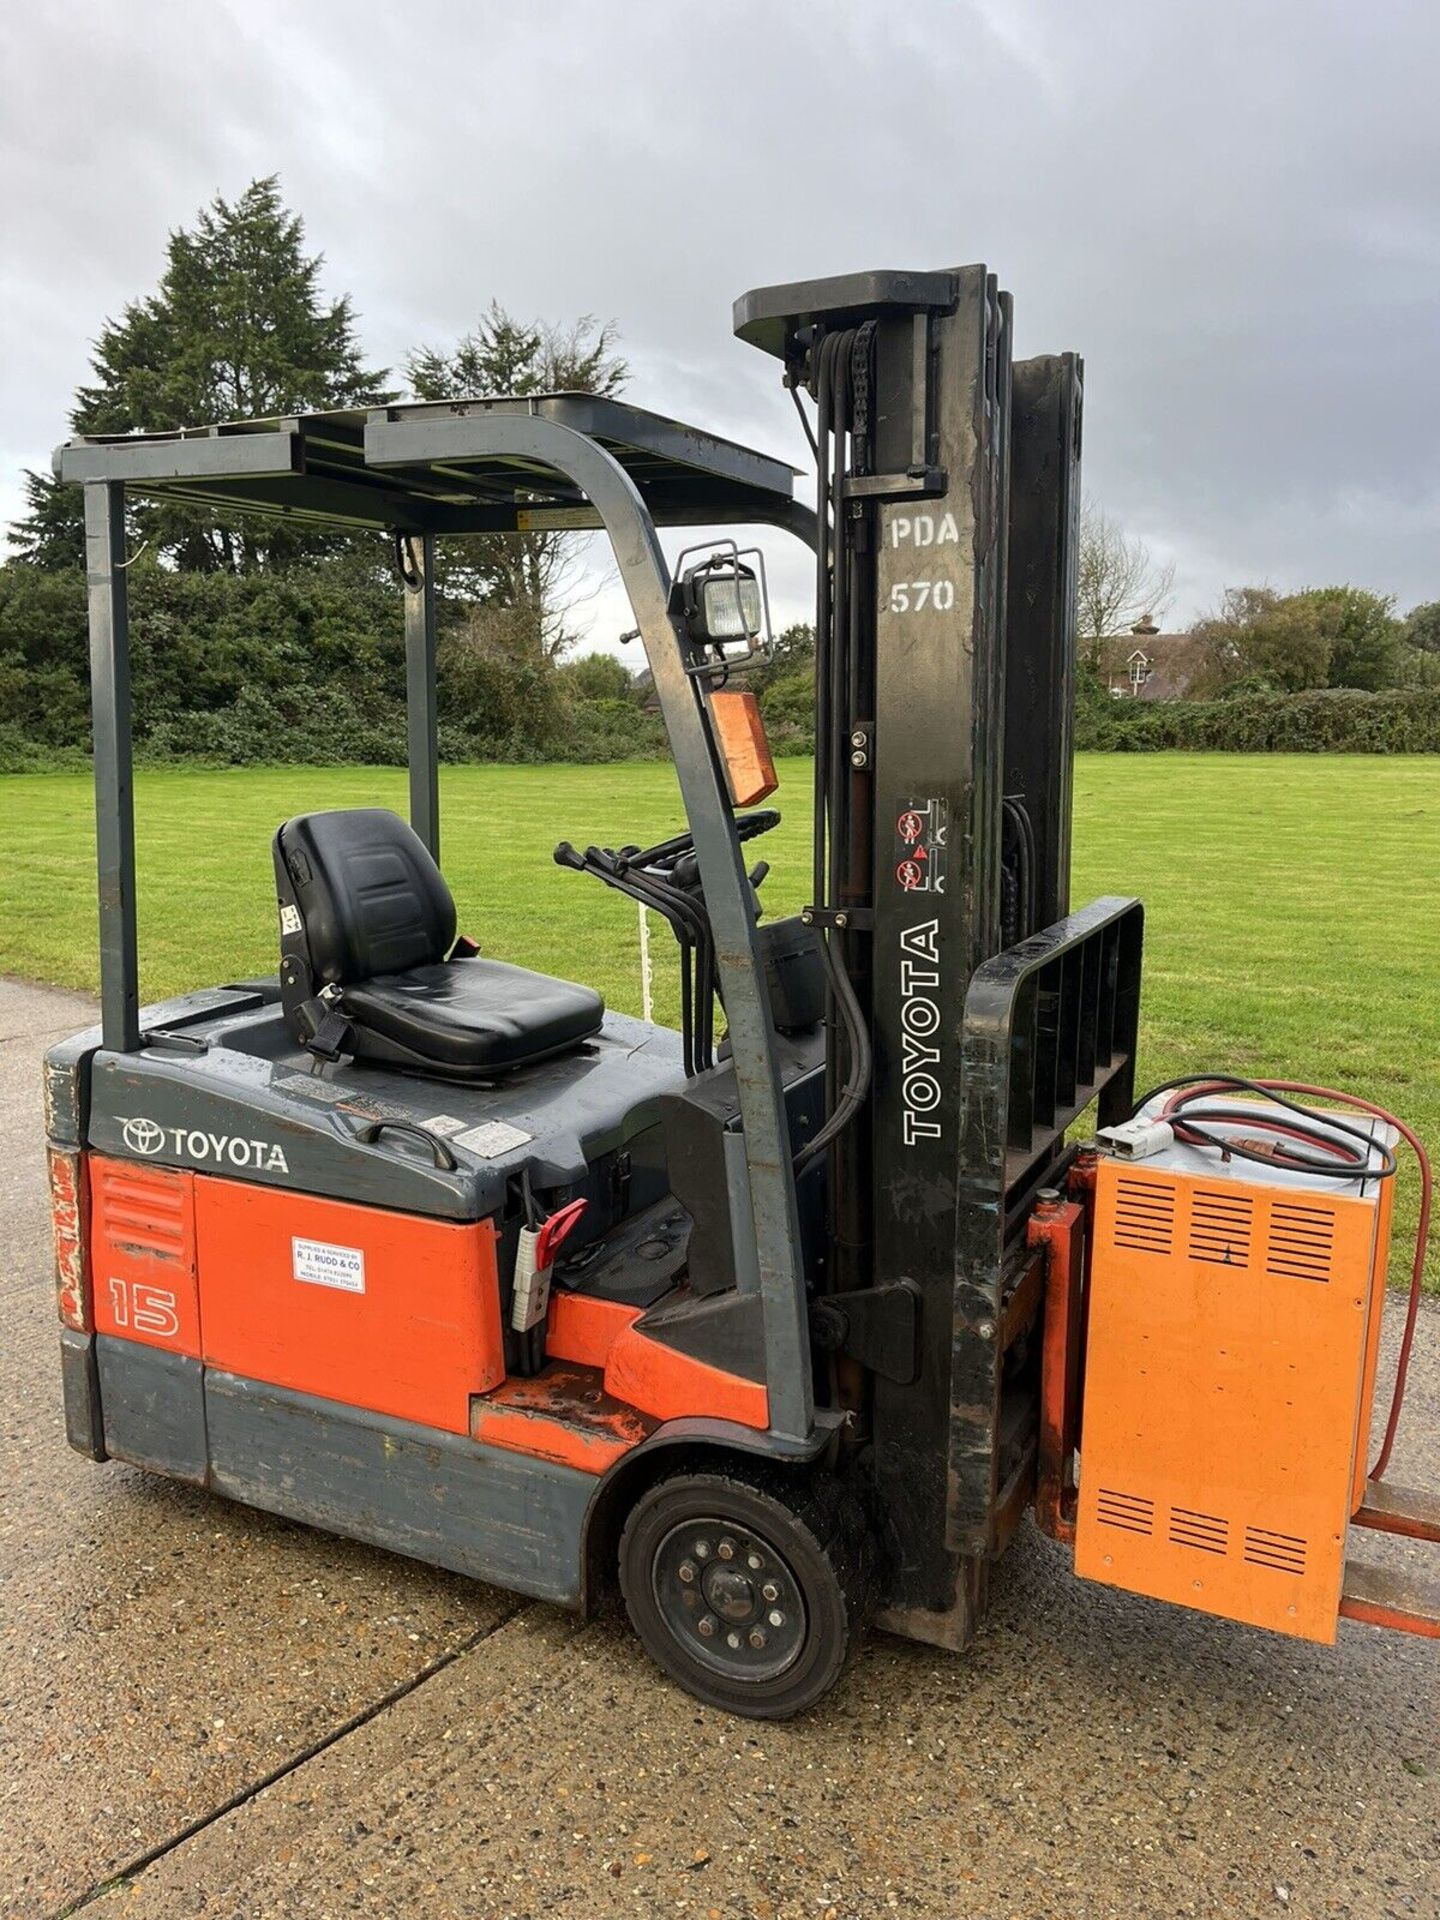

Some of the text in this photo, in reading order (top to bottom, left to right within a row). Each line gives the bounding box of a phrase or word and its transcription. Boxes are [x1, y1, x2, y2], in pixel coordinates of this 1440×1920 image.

[890, 512, 959, 549] PDA
[890, 580, 955, 613] 570
[900, 918, 942, 1146] TOYOTA
[170, 1129, 289, 1173] TOYOTA
[297, 1251, 360, 1271] R. J. RUDD & CO
[109, 1277, 179, 1337] 15
